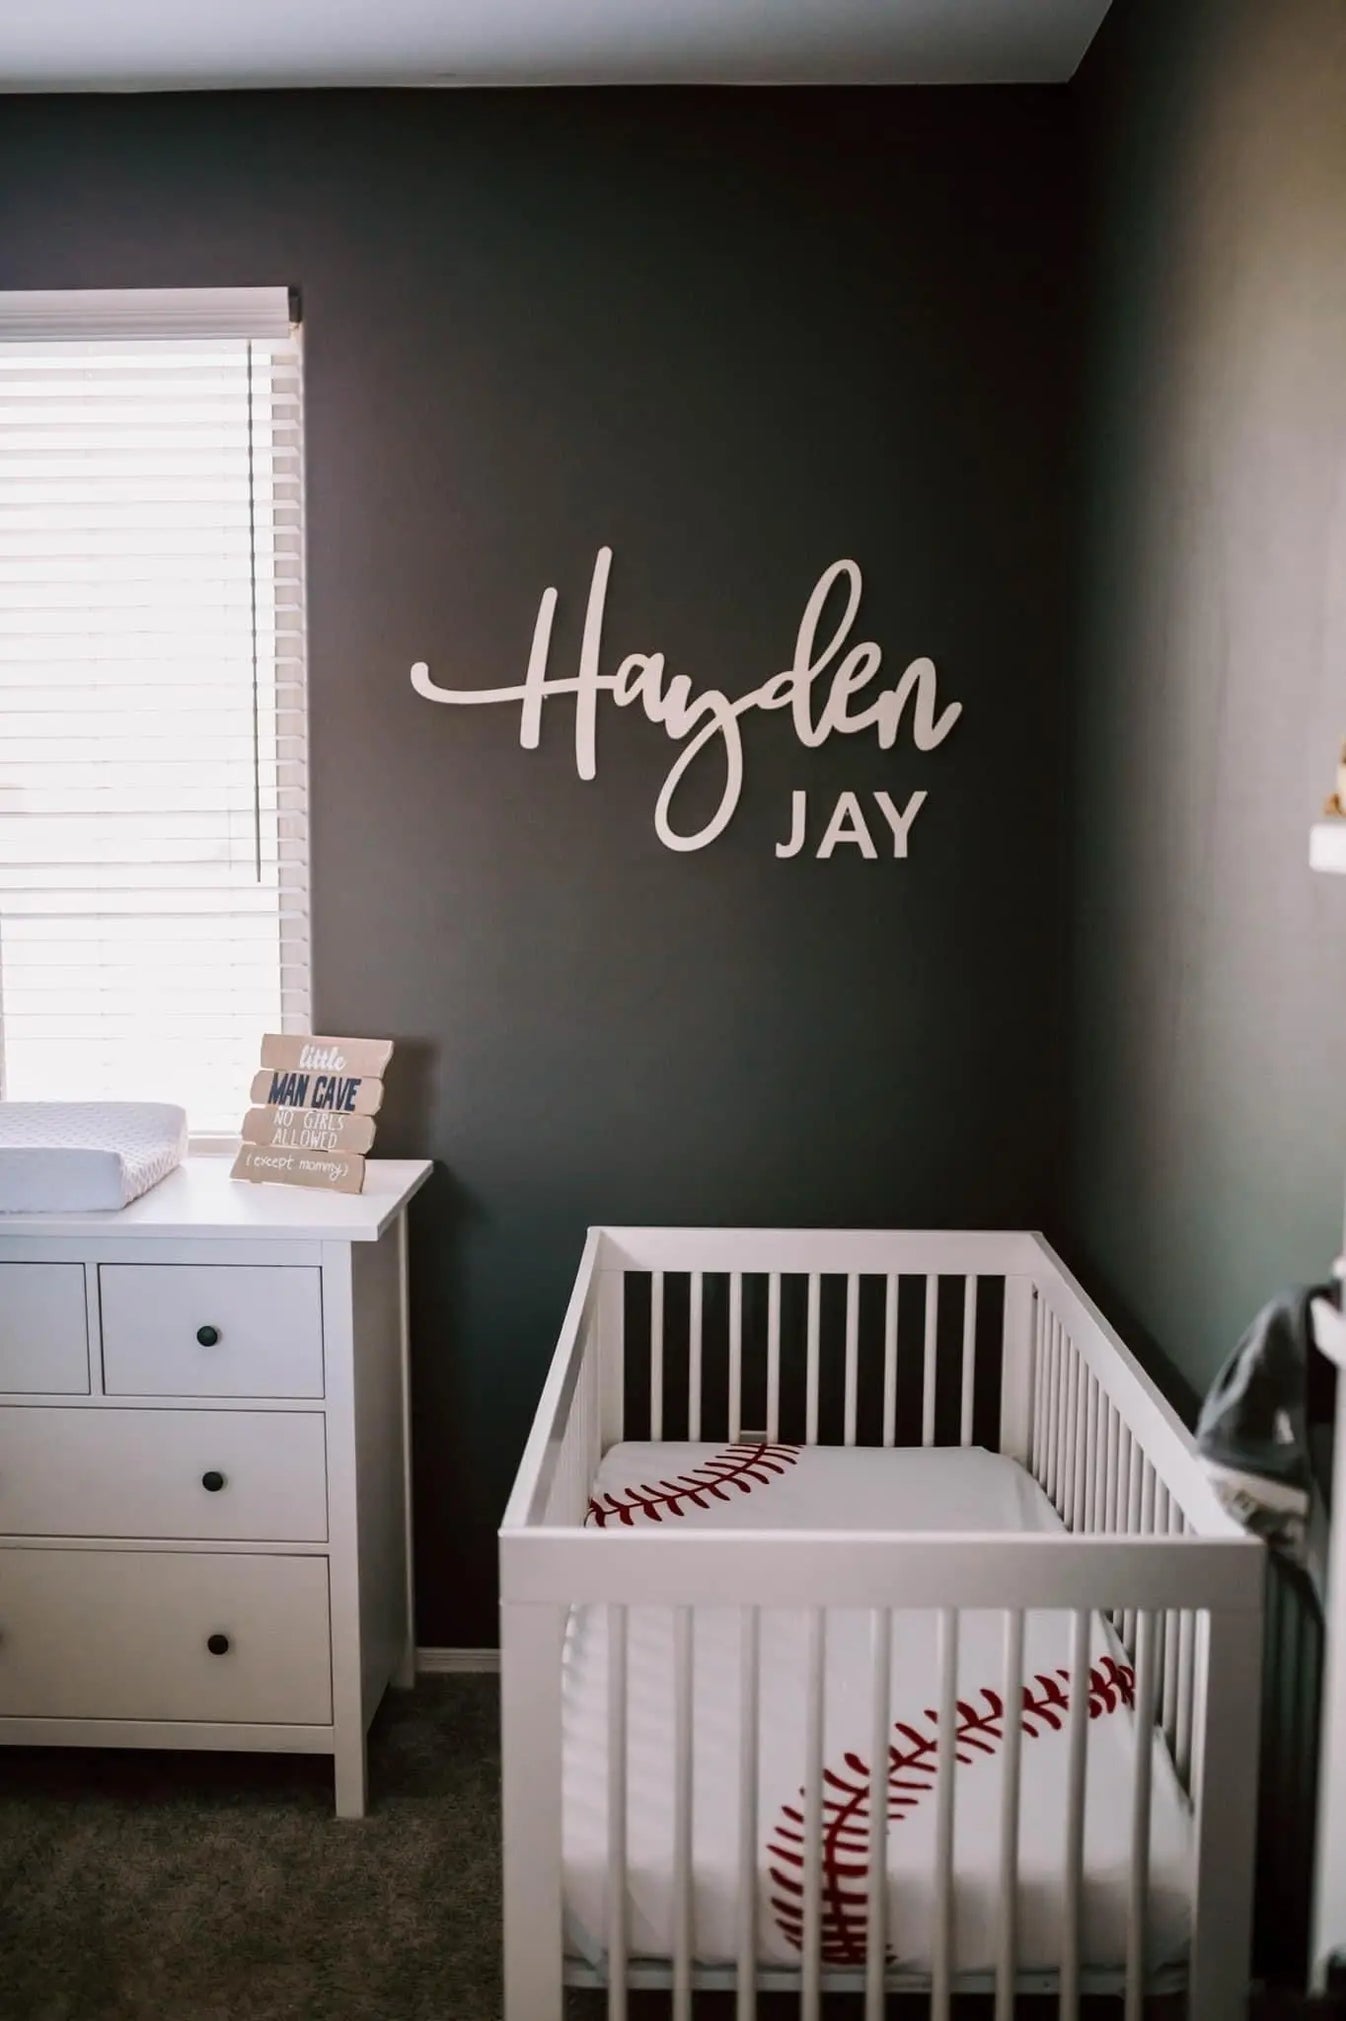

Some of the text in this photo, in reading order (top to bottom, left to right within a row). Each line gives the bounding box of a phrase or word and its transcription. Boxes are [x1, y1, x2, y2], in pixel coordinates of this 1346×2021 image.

[411, 546, 963, 852] Hayden
[775, 790, 928, 859] JAY
[299, 1044, 346, 1071] little
[268, 1072, 362, 1112] MAN CAVE
[273, 1110, 344, 1131] NO GIRLS
[272, 1129, 338, 1149] ALLOWED
